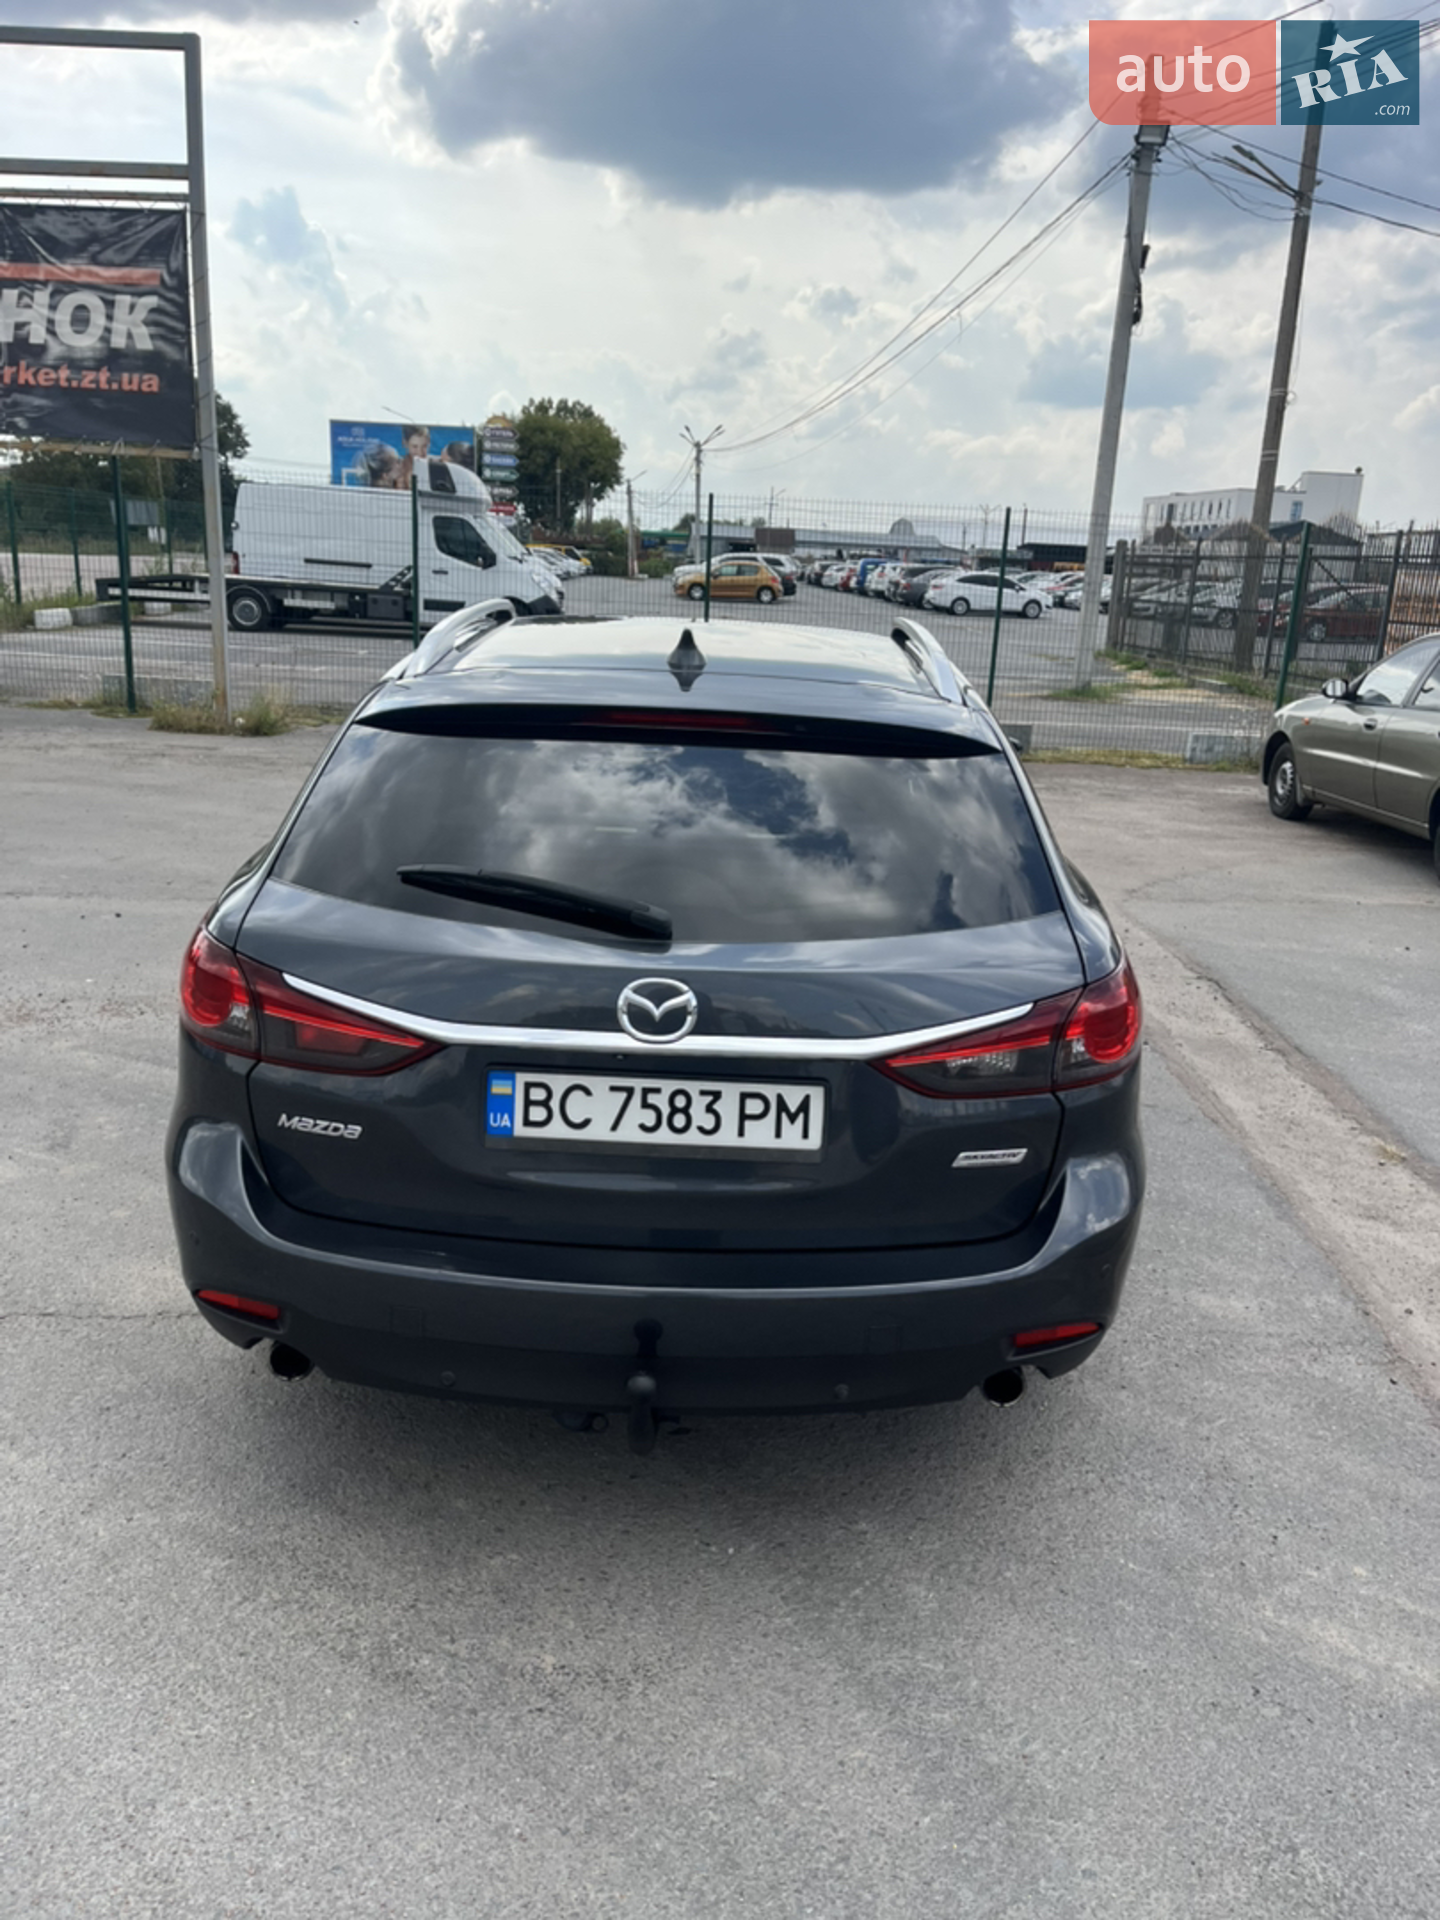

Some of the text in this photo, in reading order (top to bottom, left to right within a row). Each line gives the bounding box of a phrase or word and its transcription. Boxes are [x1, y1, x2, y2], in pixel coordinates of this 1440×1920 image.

[2, 360, 160, 393] rket.zt.ua
[489, 1112, 511, 1128] UA
[522, 1081, 811, 1140] BC 7583 PM
